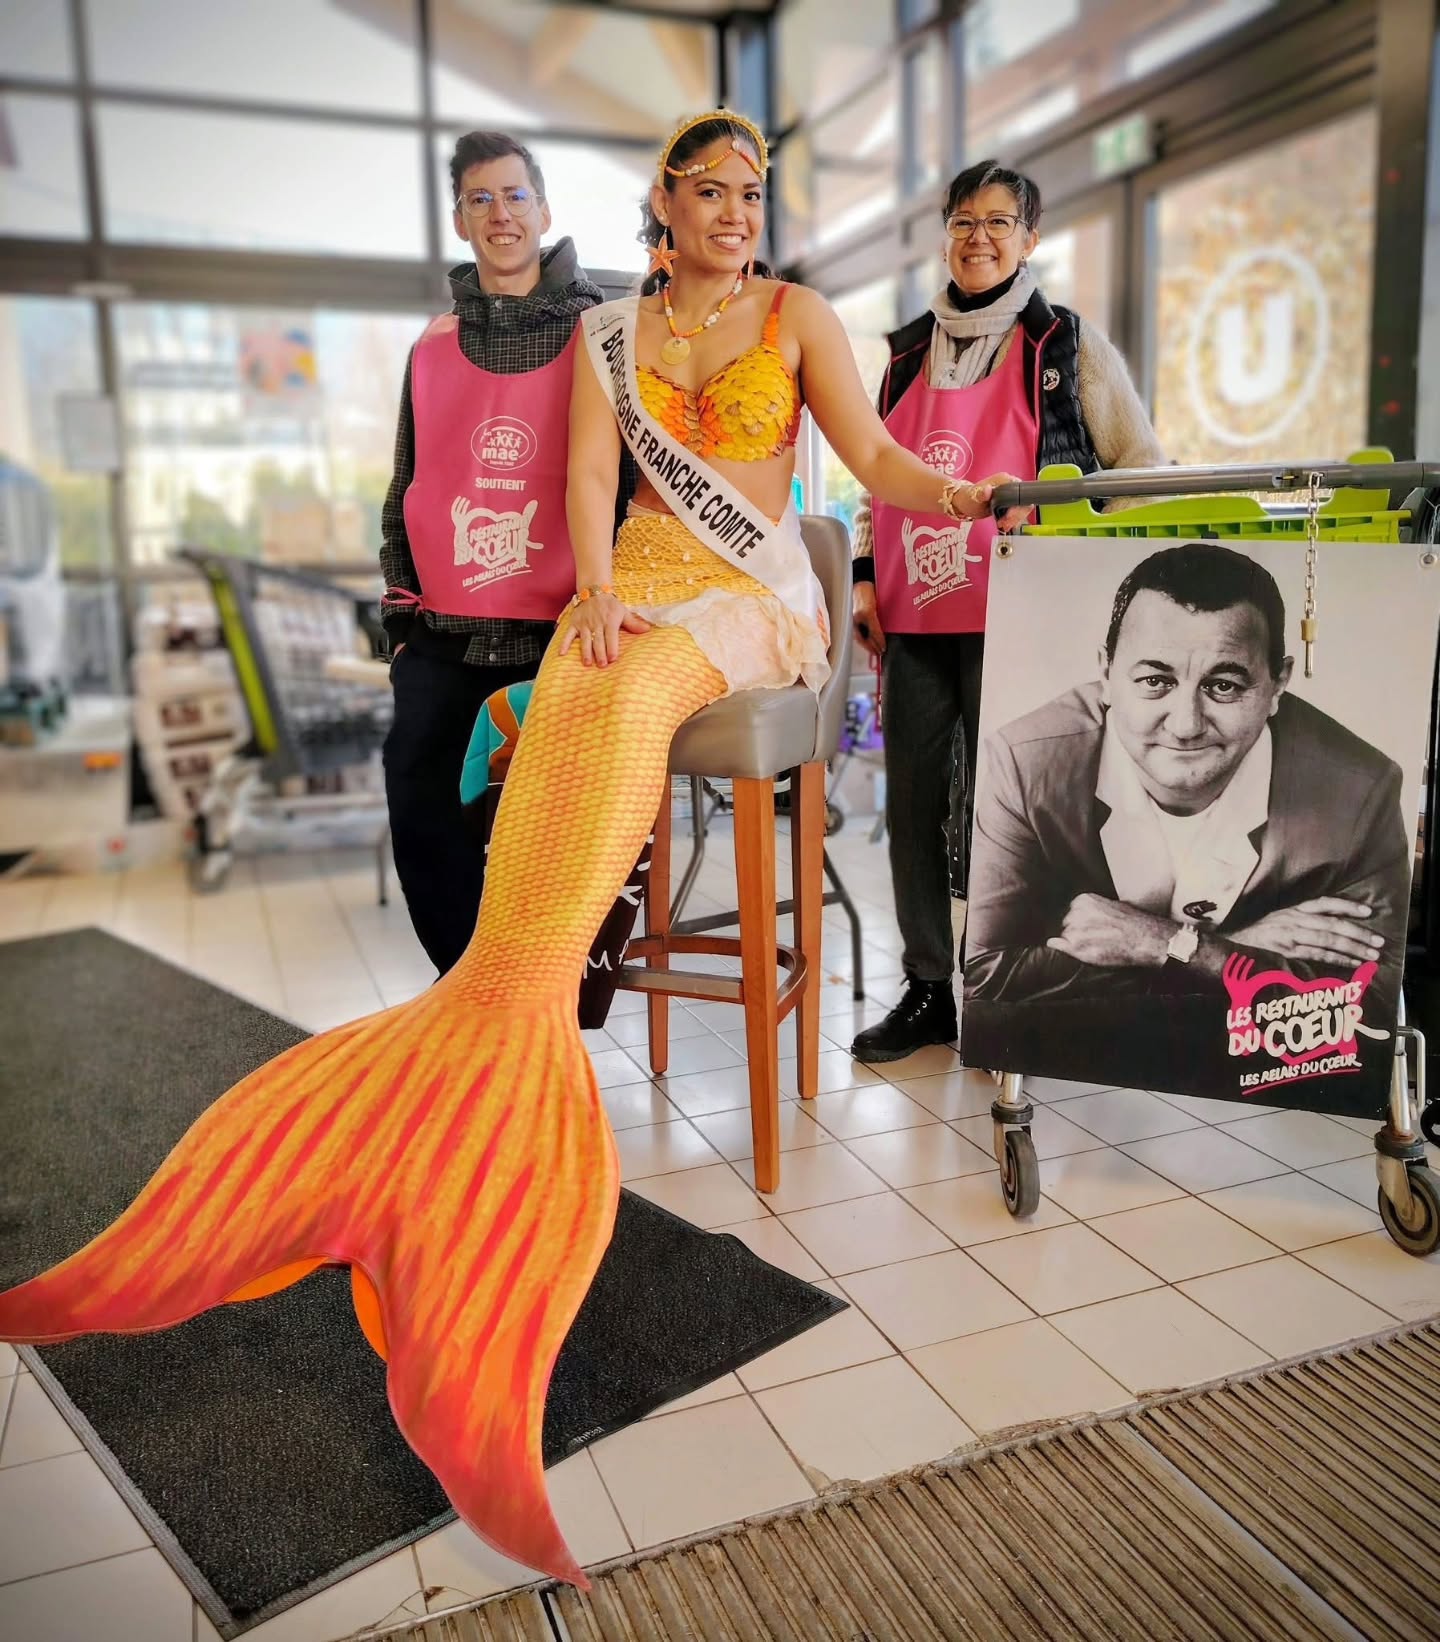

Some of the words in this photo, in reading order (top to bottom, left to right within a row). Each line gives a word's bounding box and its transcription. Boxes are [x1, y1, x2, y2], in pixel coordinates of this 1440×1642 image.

[1218, 291, 1293, 406] U
[481, 447, 520, 461] mae
[601, 327, 641, 441] BOURGOGNE
[636, 427, 711, 511] FRANCHE
[699, 494, 765, 559] COMTE
[475, 477, 527, 491] SOUTIENT
[1226, 1006, 1252, 1030] LES
[1255, 981, 1363, 1024] RESTAURANTS
[1228, 1027, 1261, 1057] DU
[1240, 1074, 1260, 1087] LES
[1260, 1064, 1300, 1084] RELAIS
[1300, 1061, 1319, 1075] DU
